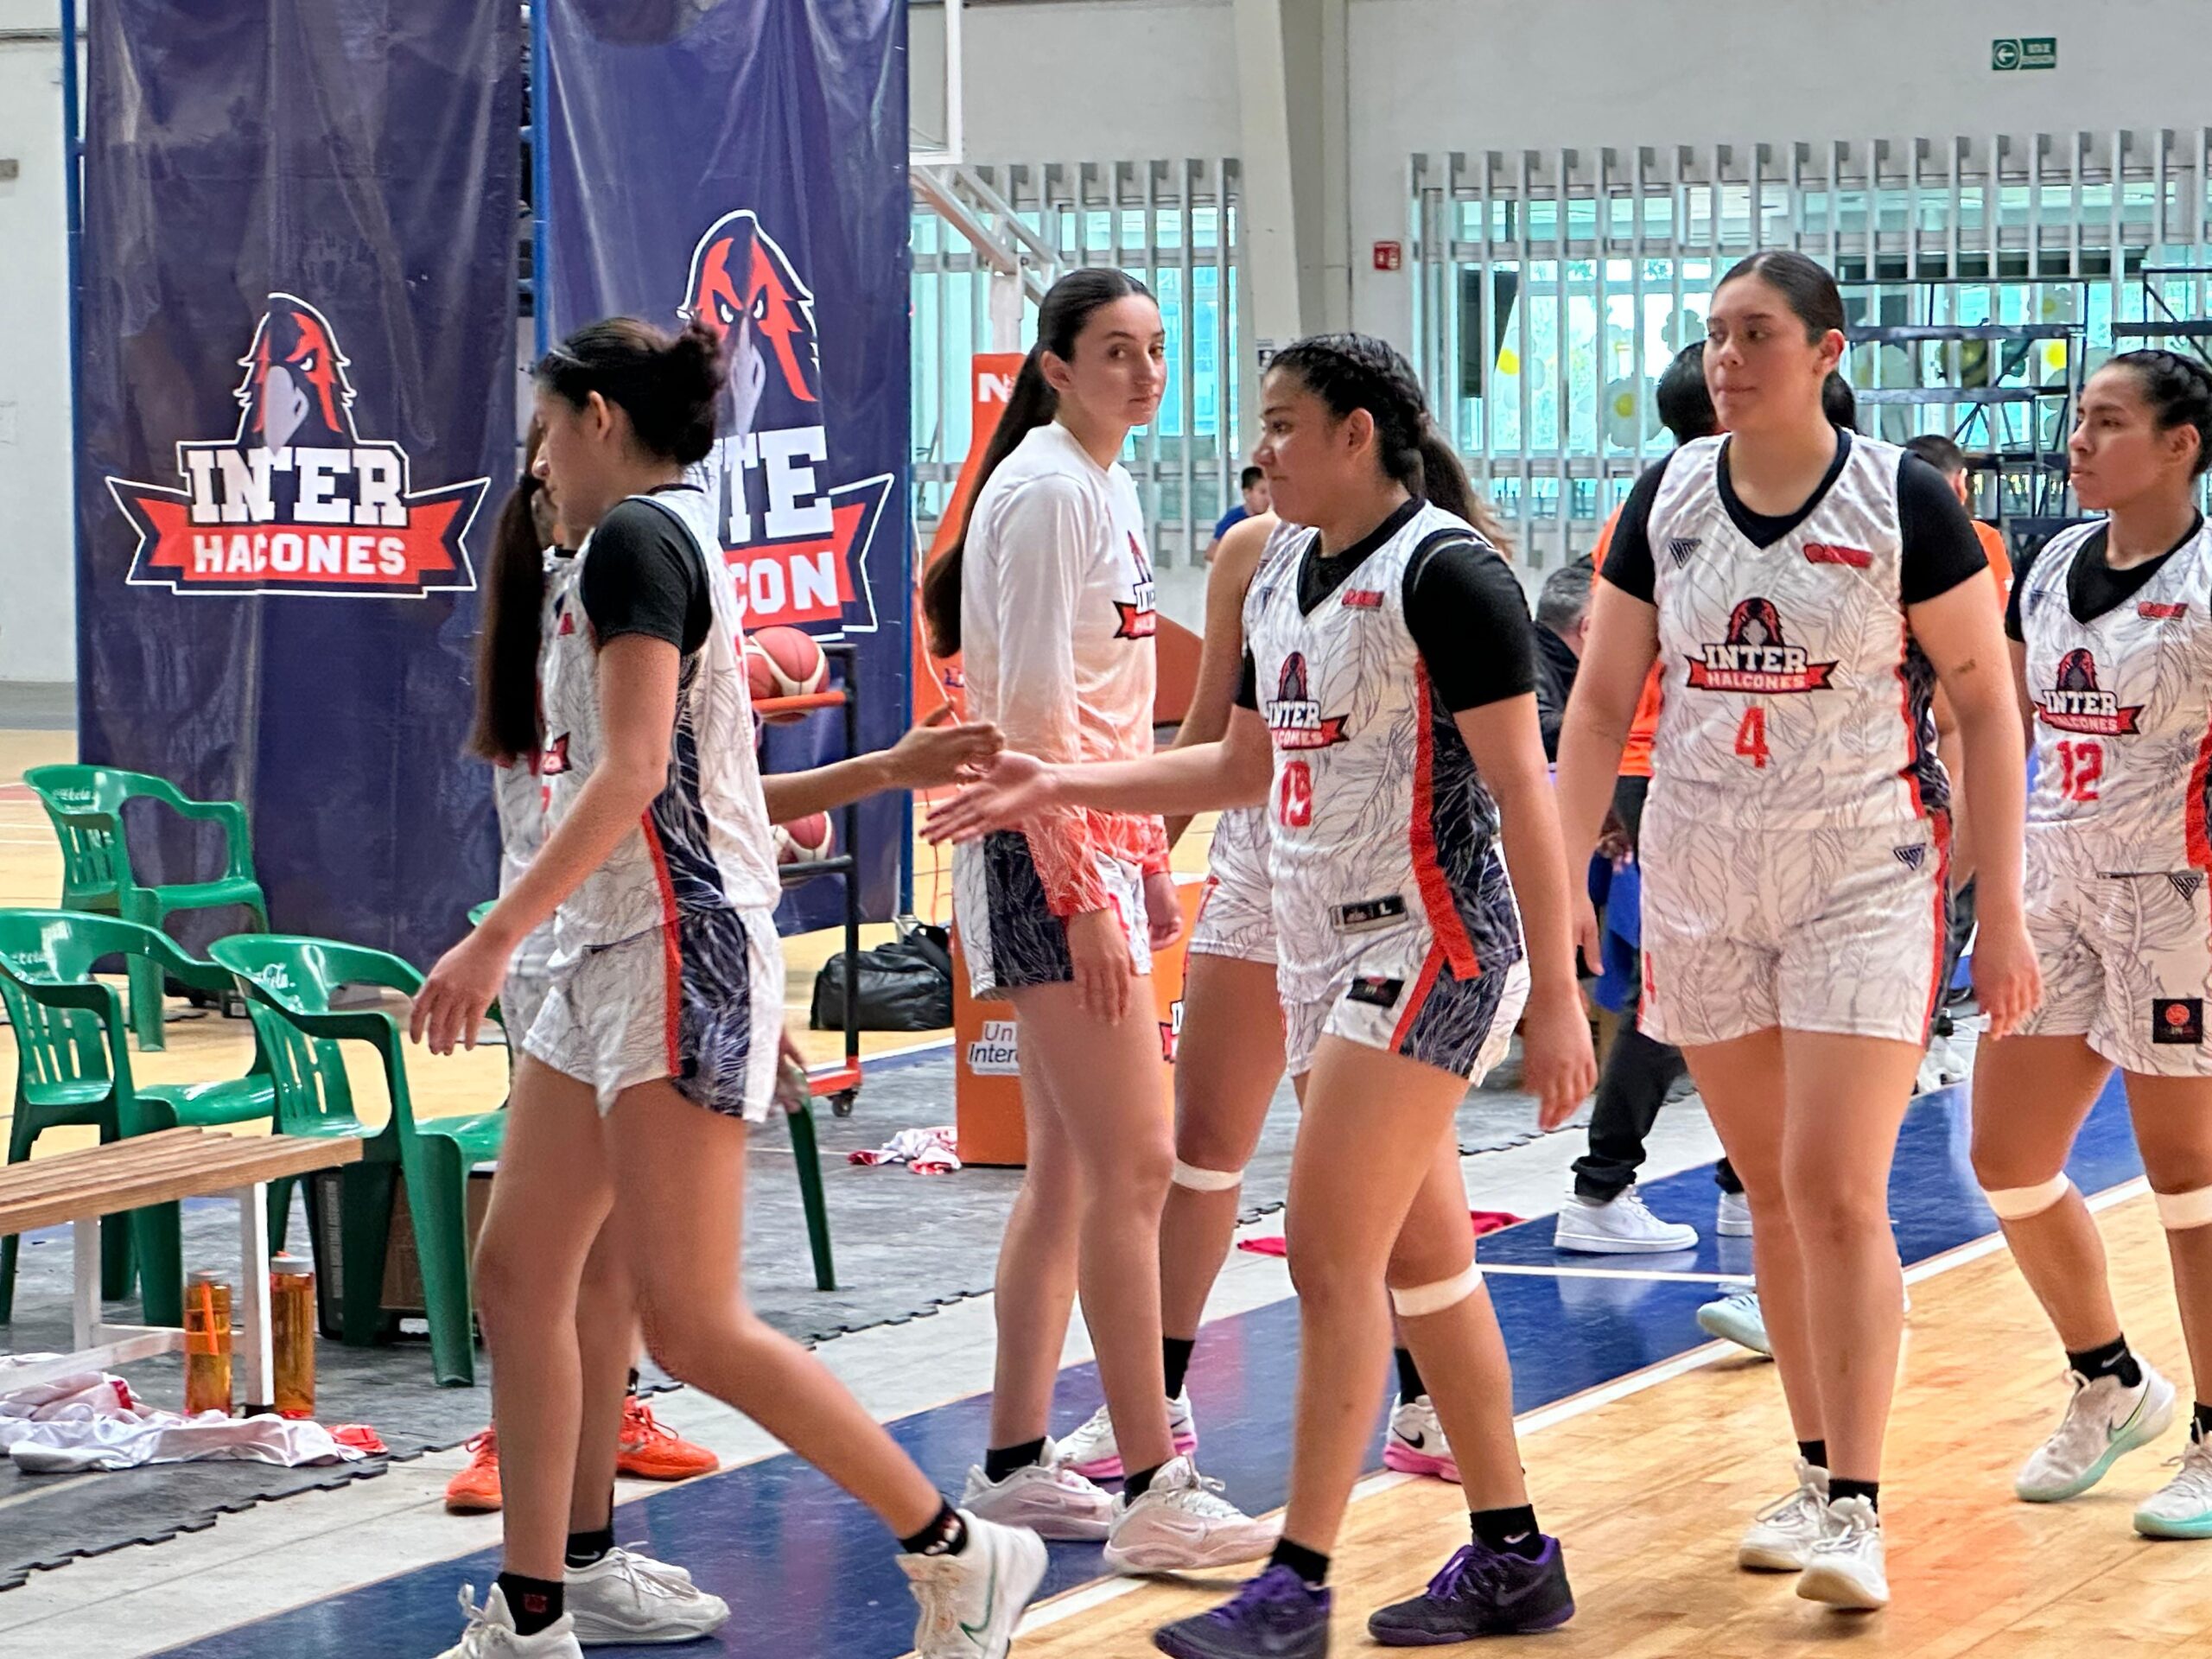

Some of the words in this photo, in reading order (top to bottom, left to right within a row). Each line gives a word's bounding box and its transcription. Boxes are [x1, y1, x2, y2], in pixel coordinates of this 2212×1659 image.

[1703, 644, 1807, 675] INTER
[1707, 671, 1807, 690] HALCONES
[2043, 690, 2119, 717] INTER
[1735, 707, 1770, 769] 4
[2057, 741, 2102, 802] 12
[969, 1043, 1019, 1064] Inter
